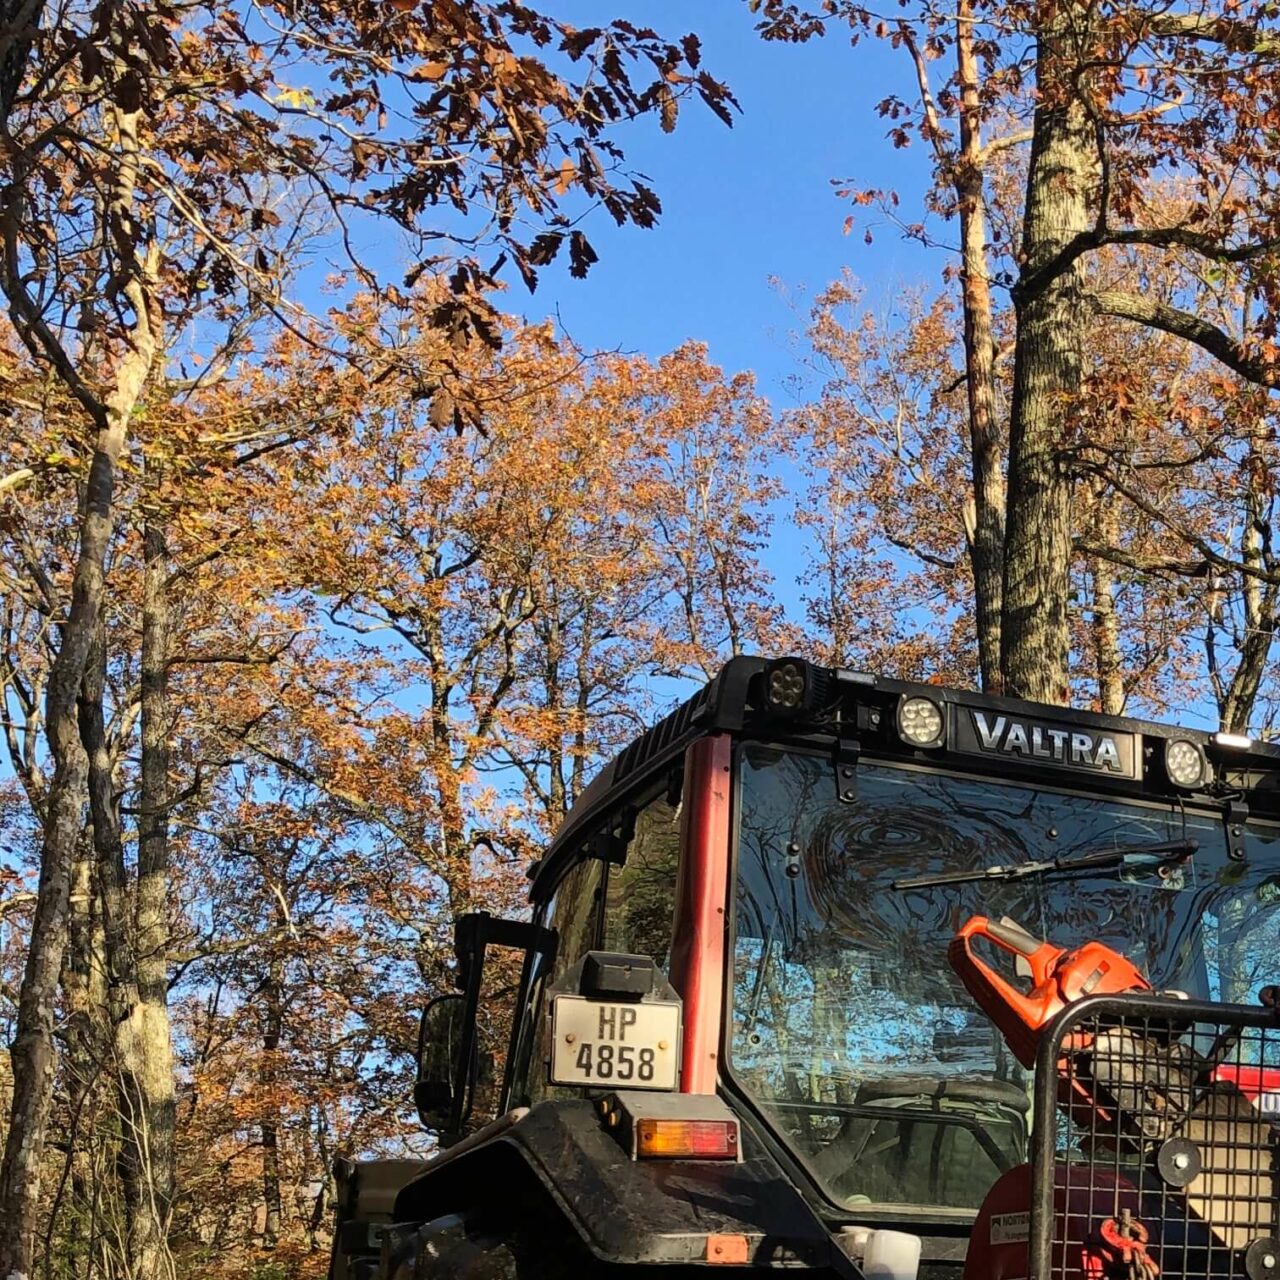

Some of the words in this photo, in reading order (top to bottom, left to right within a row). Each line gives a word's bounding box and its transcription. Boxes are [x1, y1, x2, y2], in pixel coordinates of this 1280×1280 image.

[973, 711, 1121, 768] VALTRA
[598, 1006, 637, 1041] HP
[576, 1043, 655, 1081] 4858
